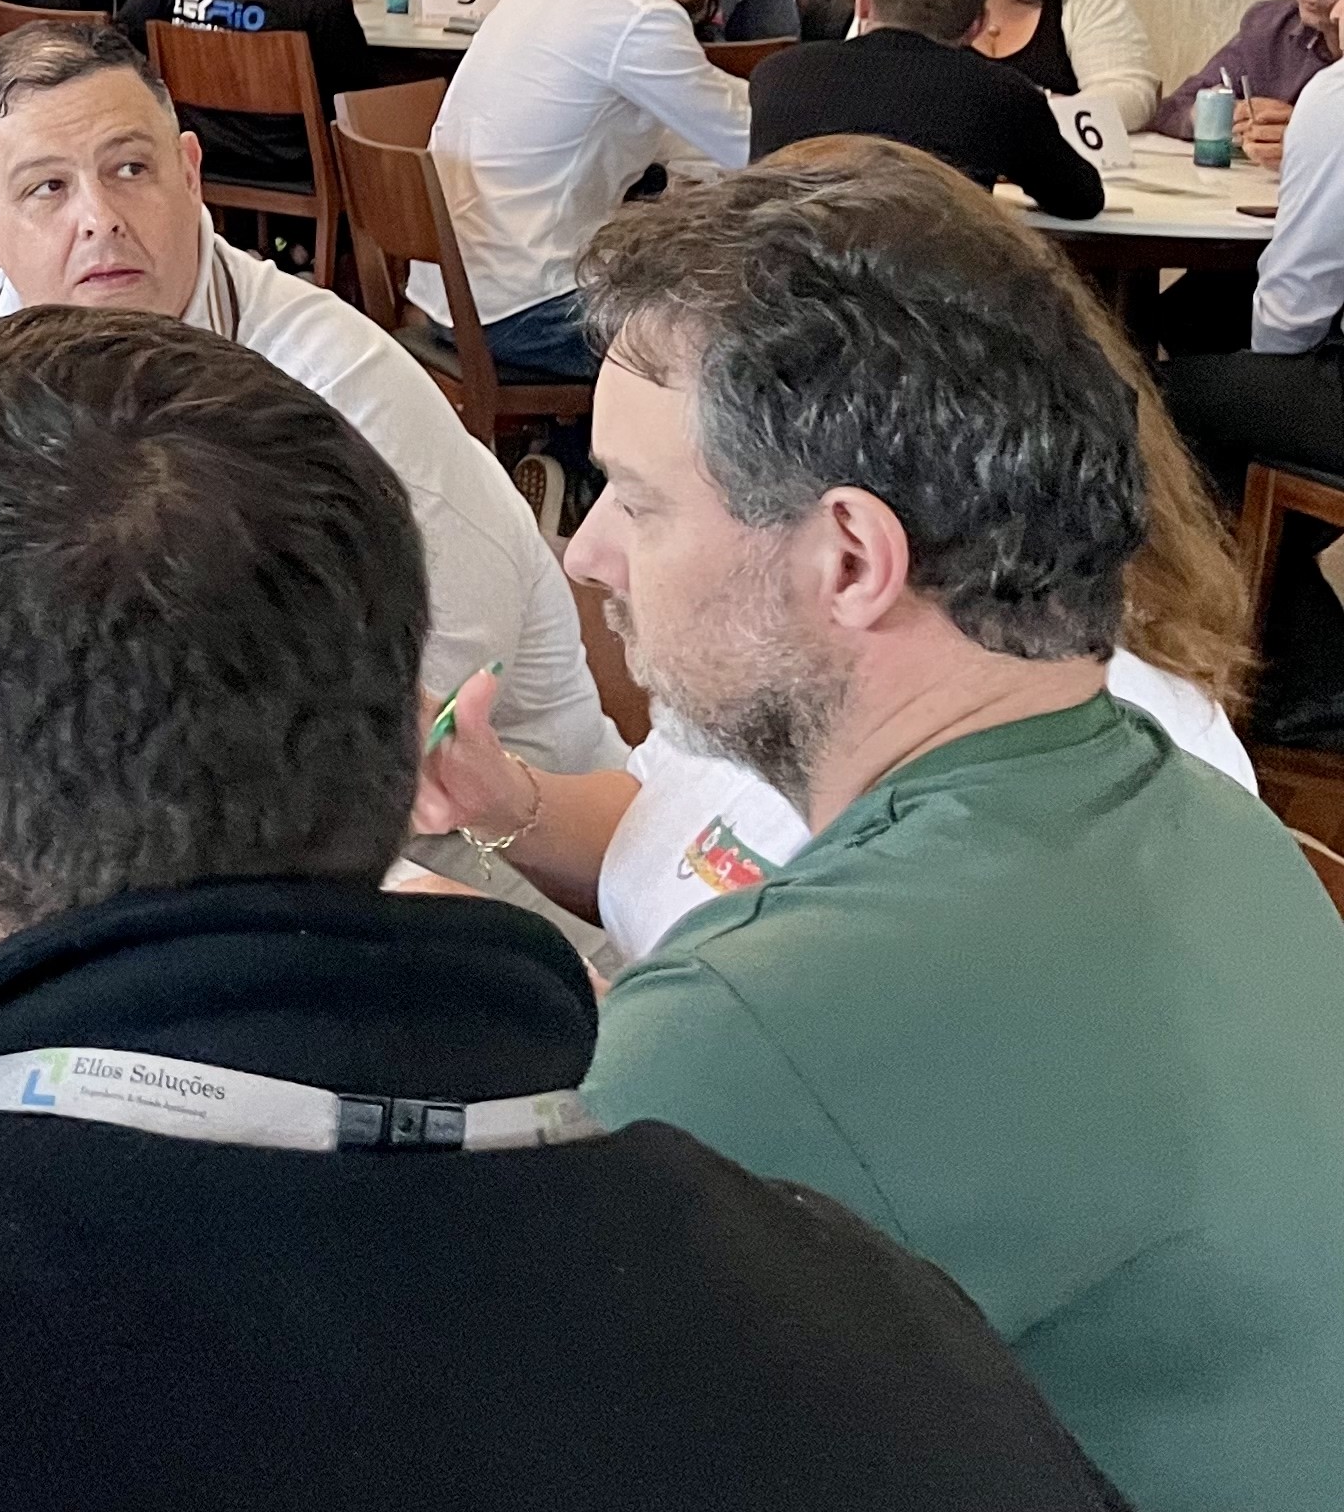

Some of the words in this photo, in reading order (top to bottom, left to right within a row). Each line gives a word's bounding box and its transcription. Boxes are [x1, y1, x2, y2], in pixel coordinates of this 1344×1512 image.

[1074, 110, 1104, 151] 6
[72, 1056, 124, 1080] Ellos
[129, 1063, 226, 1101] Soluções
